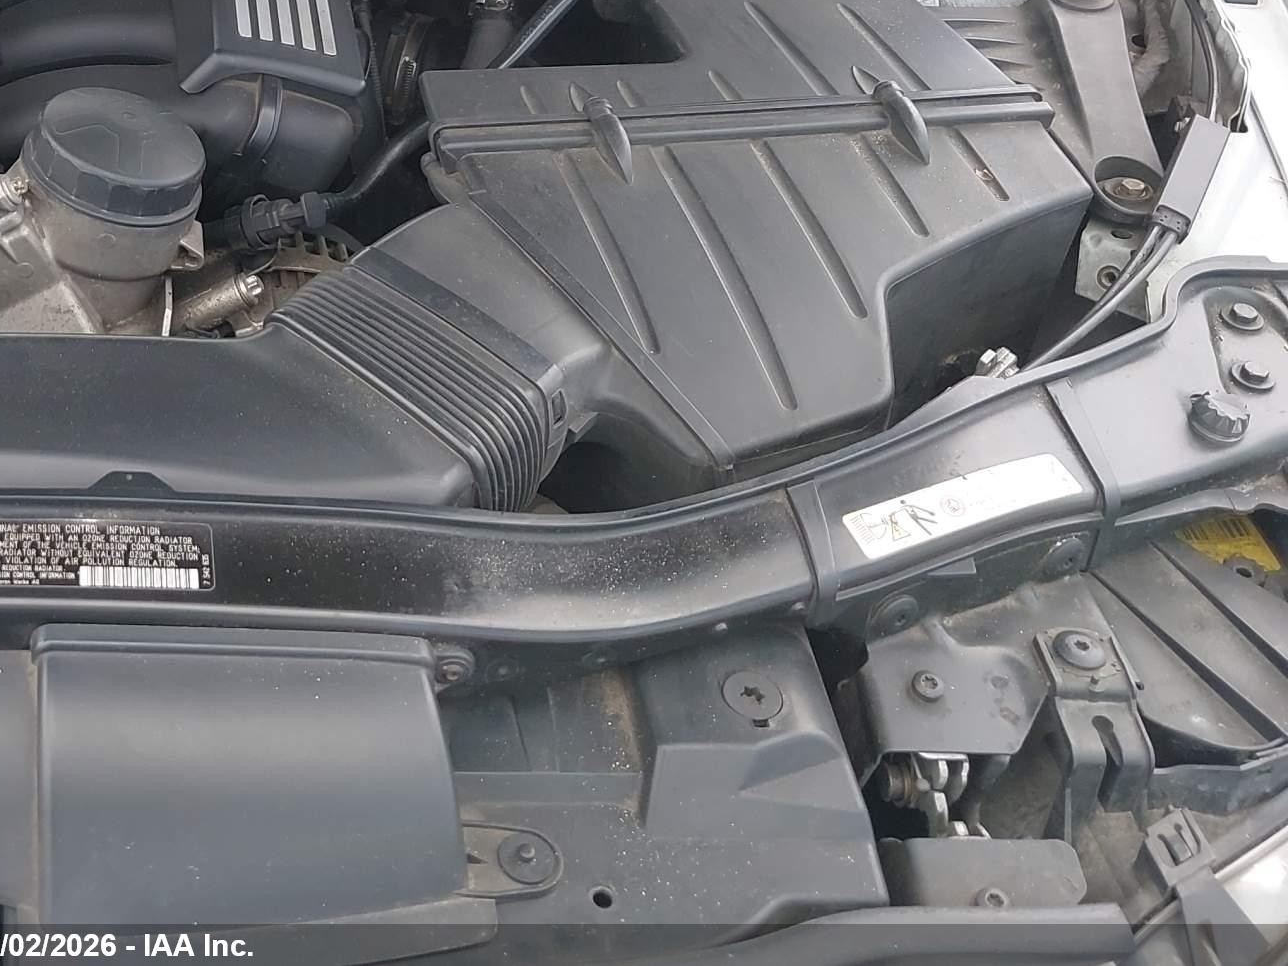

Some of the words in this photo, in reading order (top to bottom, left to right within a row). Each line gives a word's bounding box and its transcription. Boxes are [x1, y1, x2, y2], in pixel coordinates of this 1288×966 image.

[23, 523, 60, 533] EMISSION
[65, 524, 100, 534] CONTROL
[107, 525, 160, 535] INFORMATION
[5, 533, 40, 541] EQUIPPED
[44, 533, 63, 542] WITH
[68, 534, 79, 542] AN
[82, 534, 105, 543] OZONE
[109, 535, 151, 544] REDUCTION
[154, 536, 192, 545] RADIATOR
[22, 541, 32, 549] OF
[37, 541, 51, 549] THE
[55, 541, 88, 550] VEHICLE
[92, 542, 128, 551] EMISSION
[131, 543, 164, 552] CONTROL
[40, 549, 73, 558] WITHOUT
[77, 550, 125, 559] EQUIVALENT
[129, 551, 153, 560] OZONE
[157, 552, 199, 561] REDUCTION
[2, 564, 32, 572] REDUCTION
[5, 556, 47, 565] VIOLATION
[50, 556, 60, 565] OF
[64, 557, 79, 566] AIR
[82, 558, 125, 566] POLLUTION
[128, 558, 178, 568] REGULATION.
[12, 571, 37, 579] CONTROL
[39, 571, 76, 580] INFORMATION
